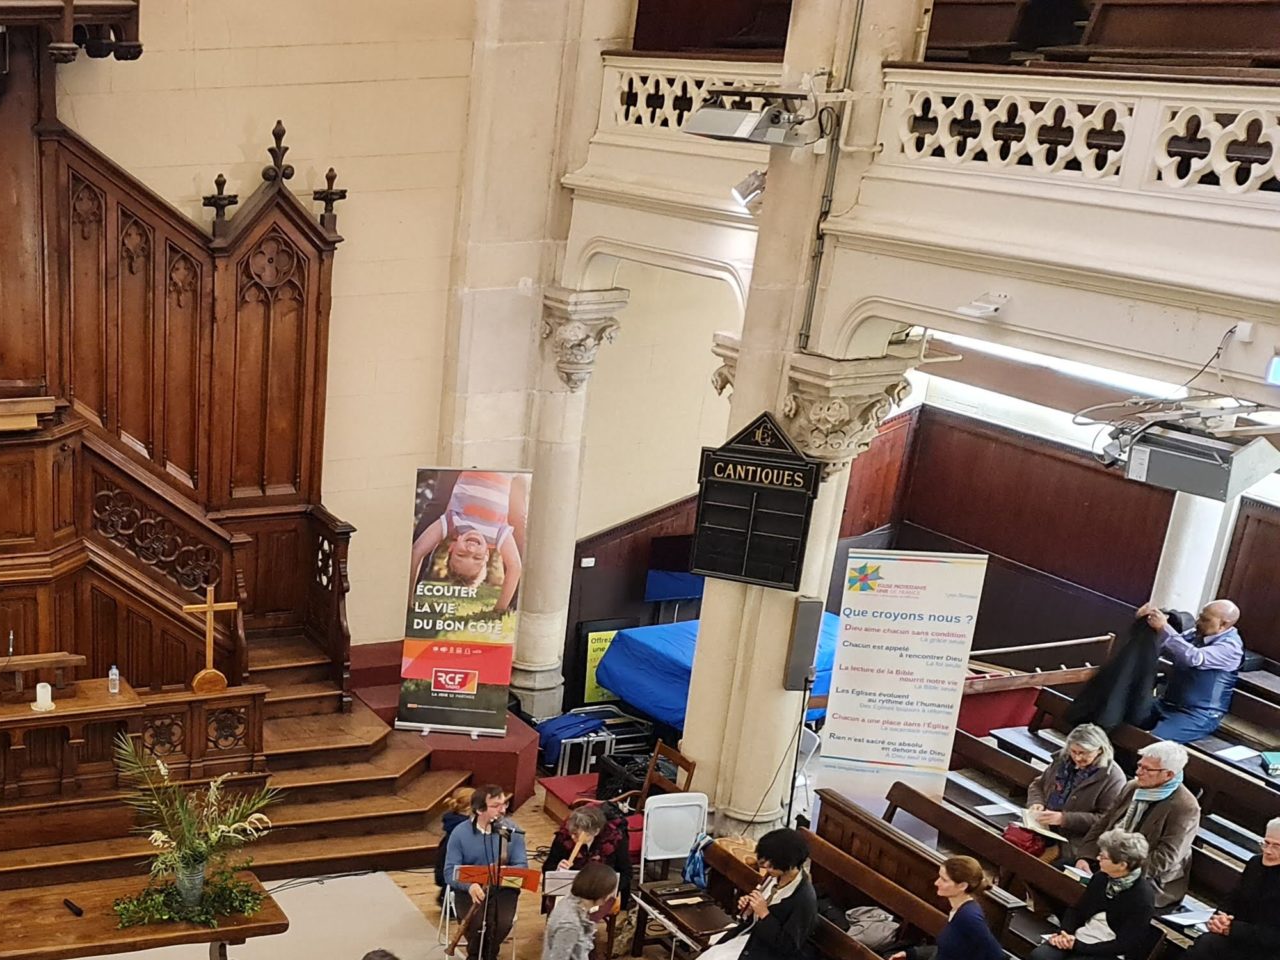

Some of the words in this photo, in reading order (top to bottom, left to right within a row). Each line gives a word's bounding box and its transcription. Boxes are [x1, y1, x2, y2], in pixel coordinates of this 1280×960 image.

[714, 462, 804, 488] CANTIQUES
[416, 582, 478, 598] ÉCOUTER
[414, 602, 431, 612] LA
[433, 602, 456, 614] VIE
[842, 607, 867, 616] Que
[872, 610, 924, 621] croyons
[928, 614, 961, 622] nous
[965, 615, 973, 623] ?
[413, 619, 432, 630] DU
[436, 620, 464, 631] BON
[468, 620, 503, 634] CÔTÉ
[842, 640, 870, 648] Chacun
[436, 672, 464, 685] RCF
[915, 701, 953, 709] l'humanité
[831, 713, 858, 721] Chacun
[828, 732, 845, 740] Rien
